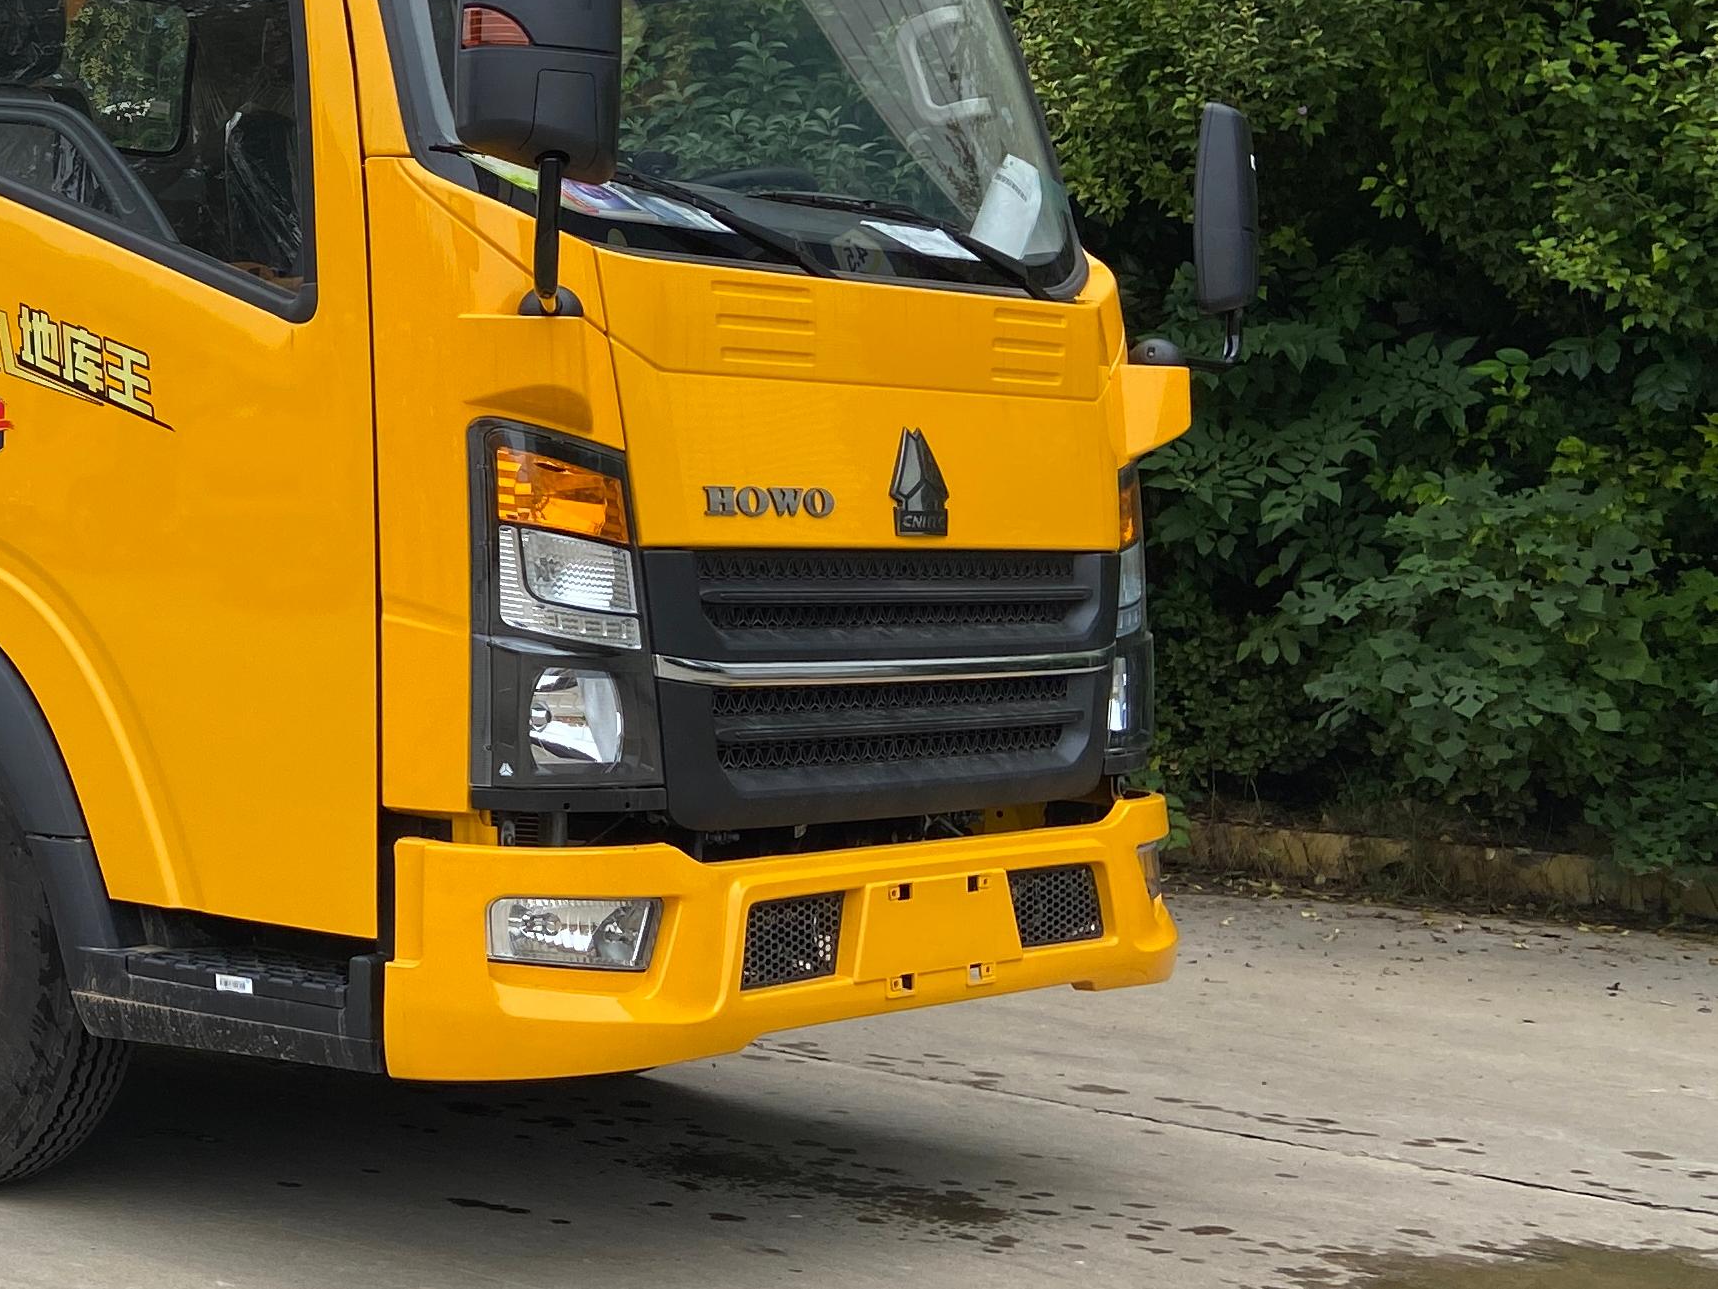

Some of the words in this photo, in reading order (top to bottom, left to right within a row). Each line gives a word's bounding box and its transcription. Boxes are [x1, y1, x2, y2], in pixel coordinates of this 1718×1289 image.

[19, 303, 155, 419] 地库王
[703, 486, 835, 518] HOWO
